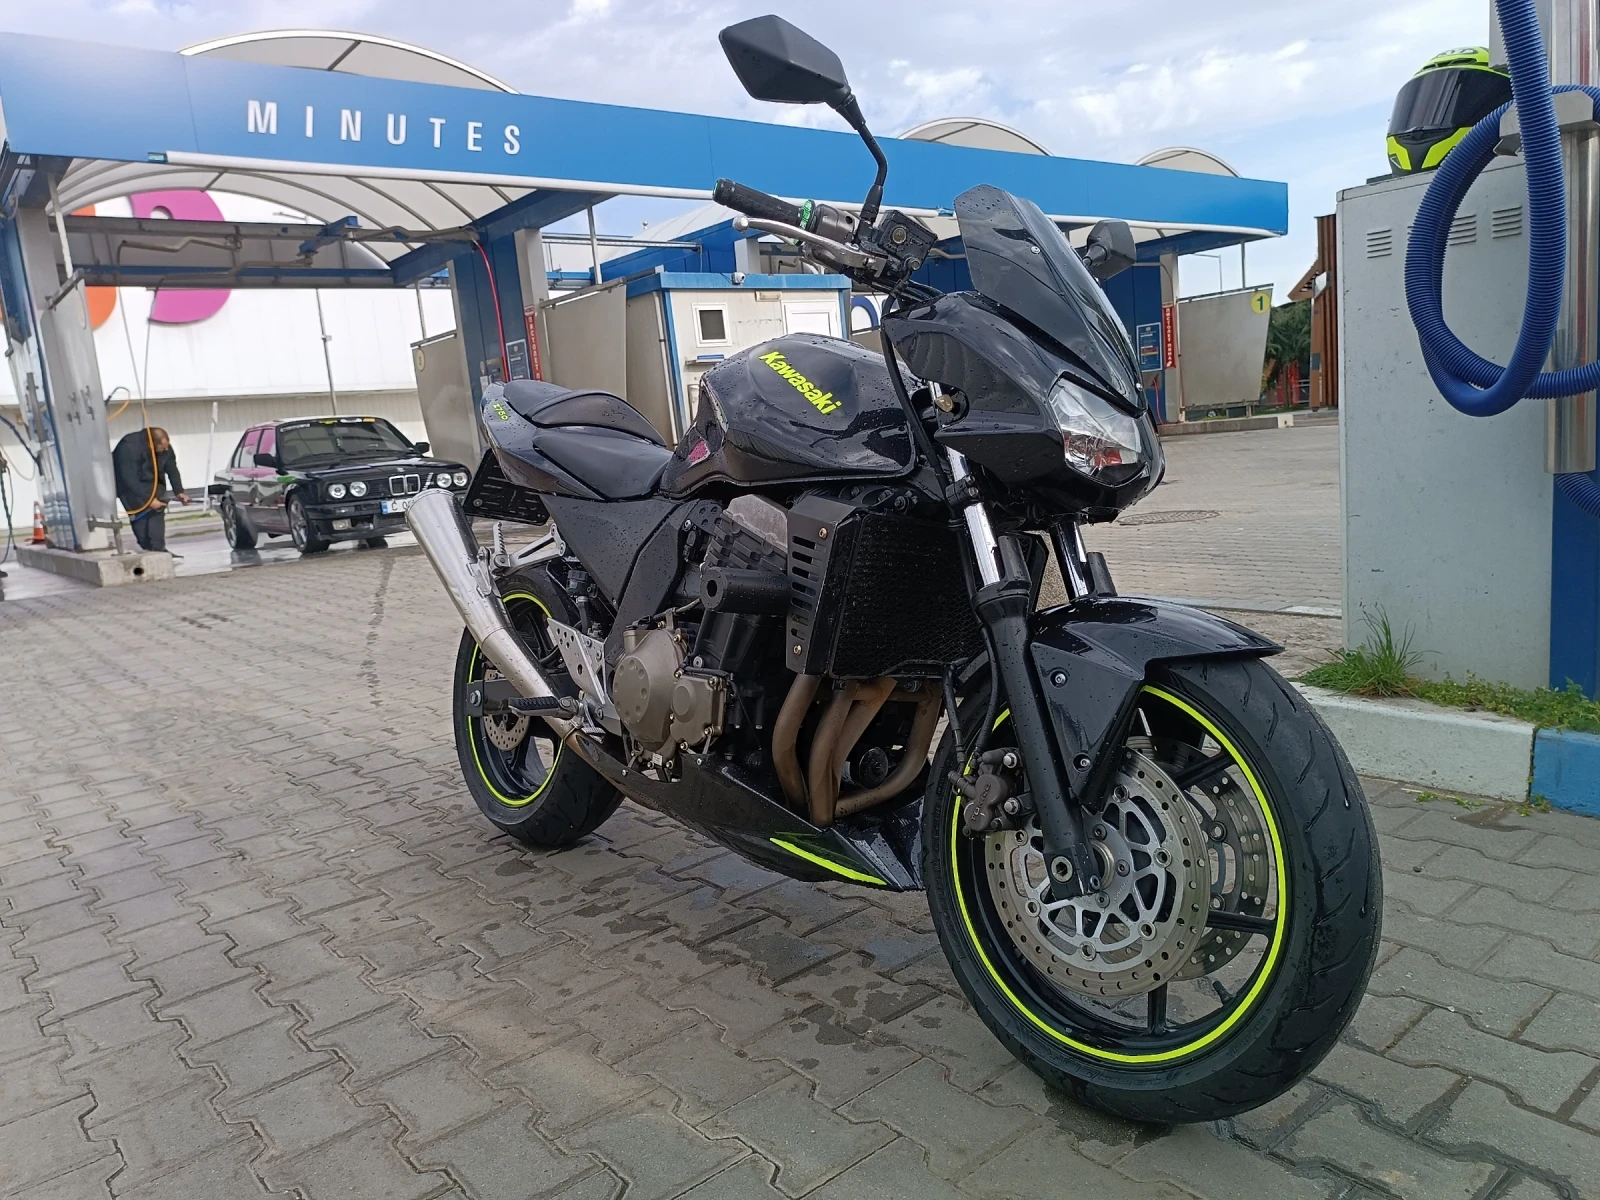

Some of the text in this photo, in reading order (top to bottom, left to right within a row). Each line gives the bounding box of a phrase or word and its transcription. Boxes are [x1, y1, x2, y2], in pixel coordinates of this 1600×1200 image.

[247, 99, 521, 155] MINUTES
[1256, 295, 1263, 310] 1
[759, 351, 842, 415] Kawasaki
